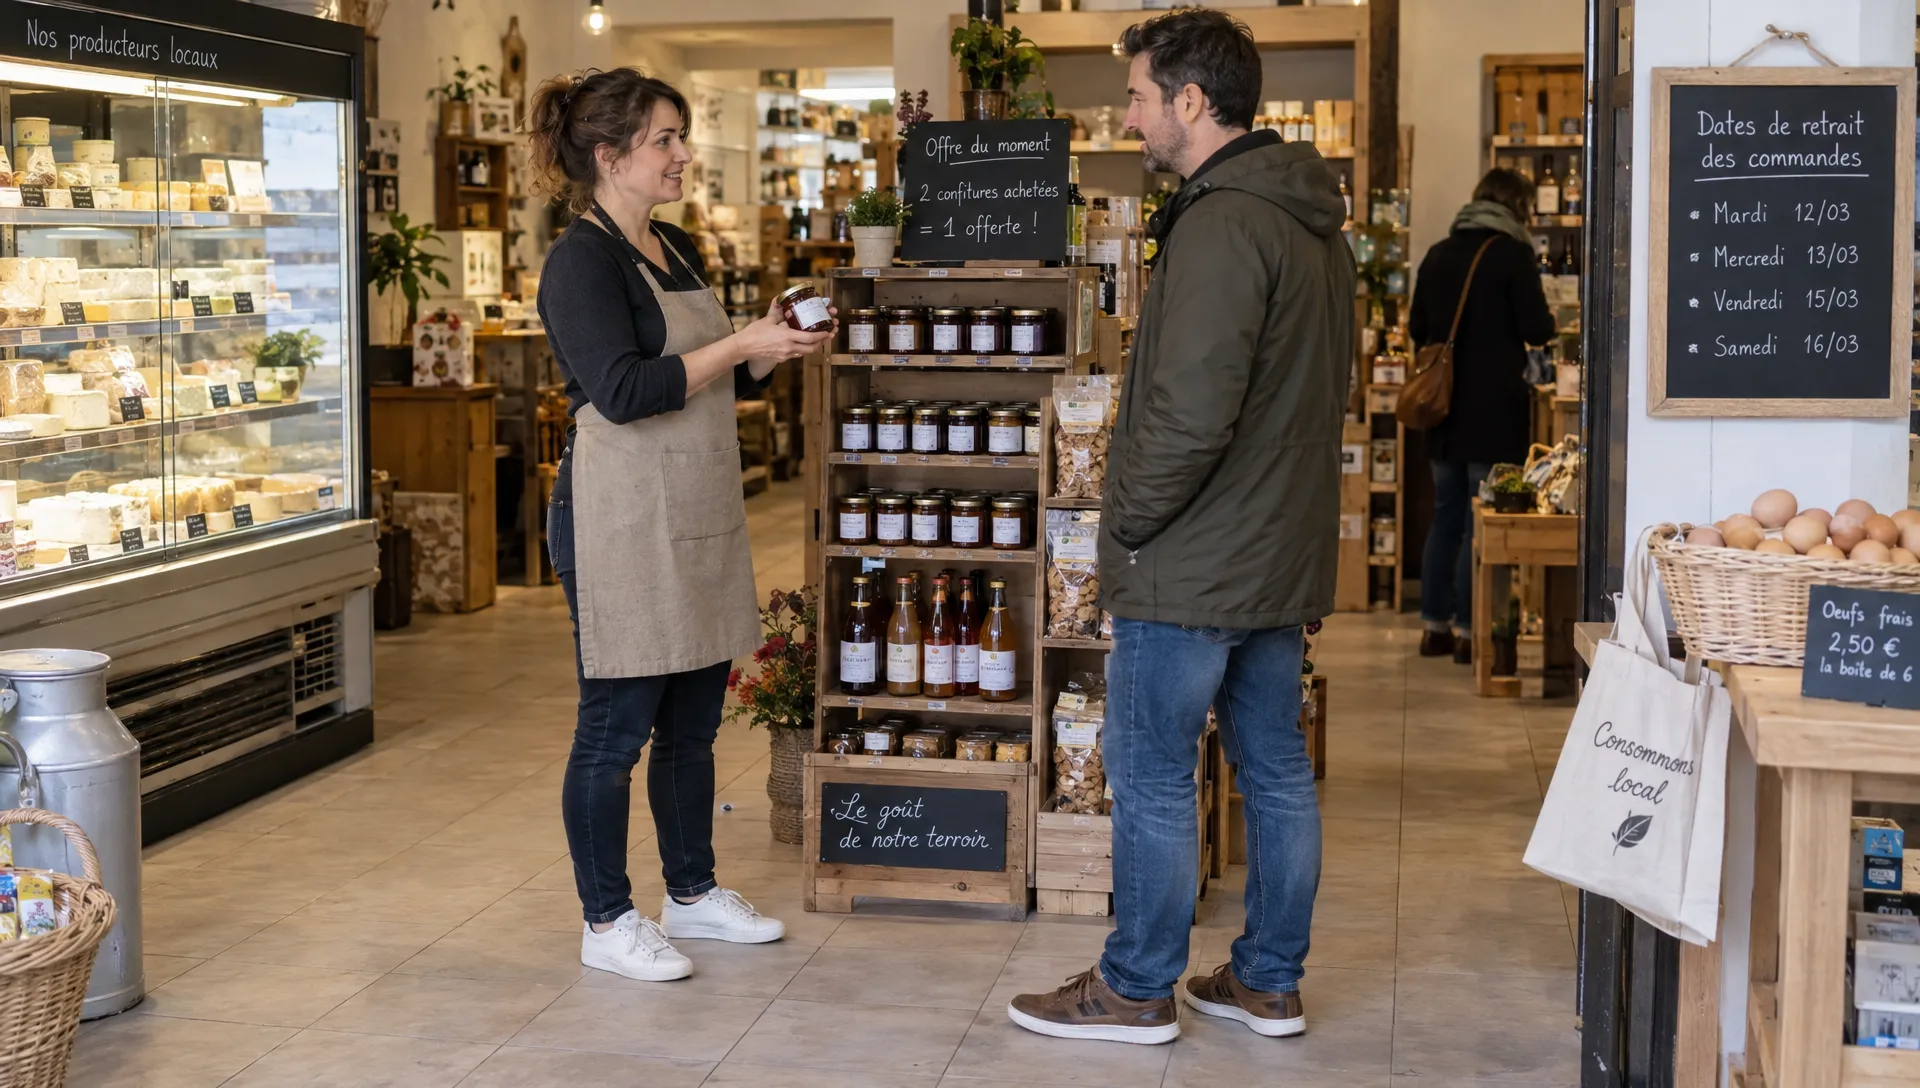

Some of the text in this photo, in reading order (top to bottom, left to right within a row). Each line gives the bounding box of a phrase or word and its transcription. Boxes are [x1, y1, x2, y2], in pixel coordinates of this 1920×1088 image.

[28, 19, 218, 70] Nos producteurs locaux
[1697, 109, 1865, 137] Dates de retrait
[926, 132, 1052, 164] Offre du moment
[1702, 143, 1862, 168] des commandes
[920, 180, 1059, 207] 2 confitures achetées
[1714, 200, 1850, 226] Mardi 12/03
[943, 216, 956, 238] 1
[965, 215, 1022, 243] offerte
[1714, 243, 1859, 269] Mercredi 13/03
[1713, 287, 1859, 312] Vendredi 15/03
[1714, 331, 1859, 359] Samedi 16/03
[1822, 600, 1914, 630] Oeufs frais
[1828, 631, 1901, 658] 2,50 €
[1819, 656, 1833, 674] la
[1879, 663, 1897, 681] de
[1902, 666, 1914, 683] 6
[1593, 720, 1696, 777] Consommons
[1608, 768, 1669, 806] local
[835, 792, 924, 830] Le goût
[839, 826, 990, 849] de notre terroir
